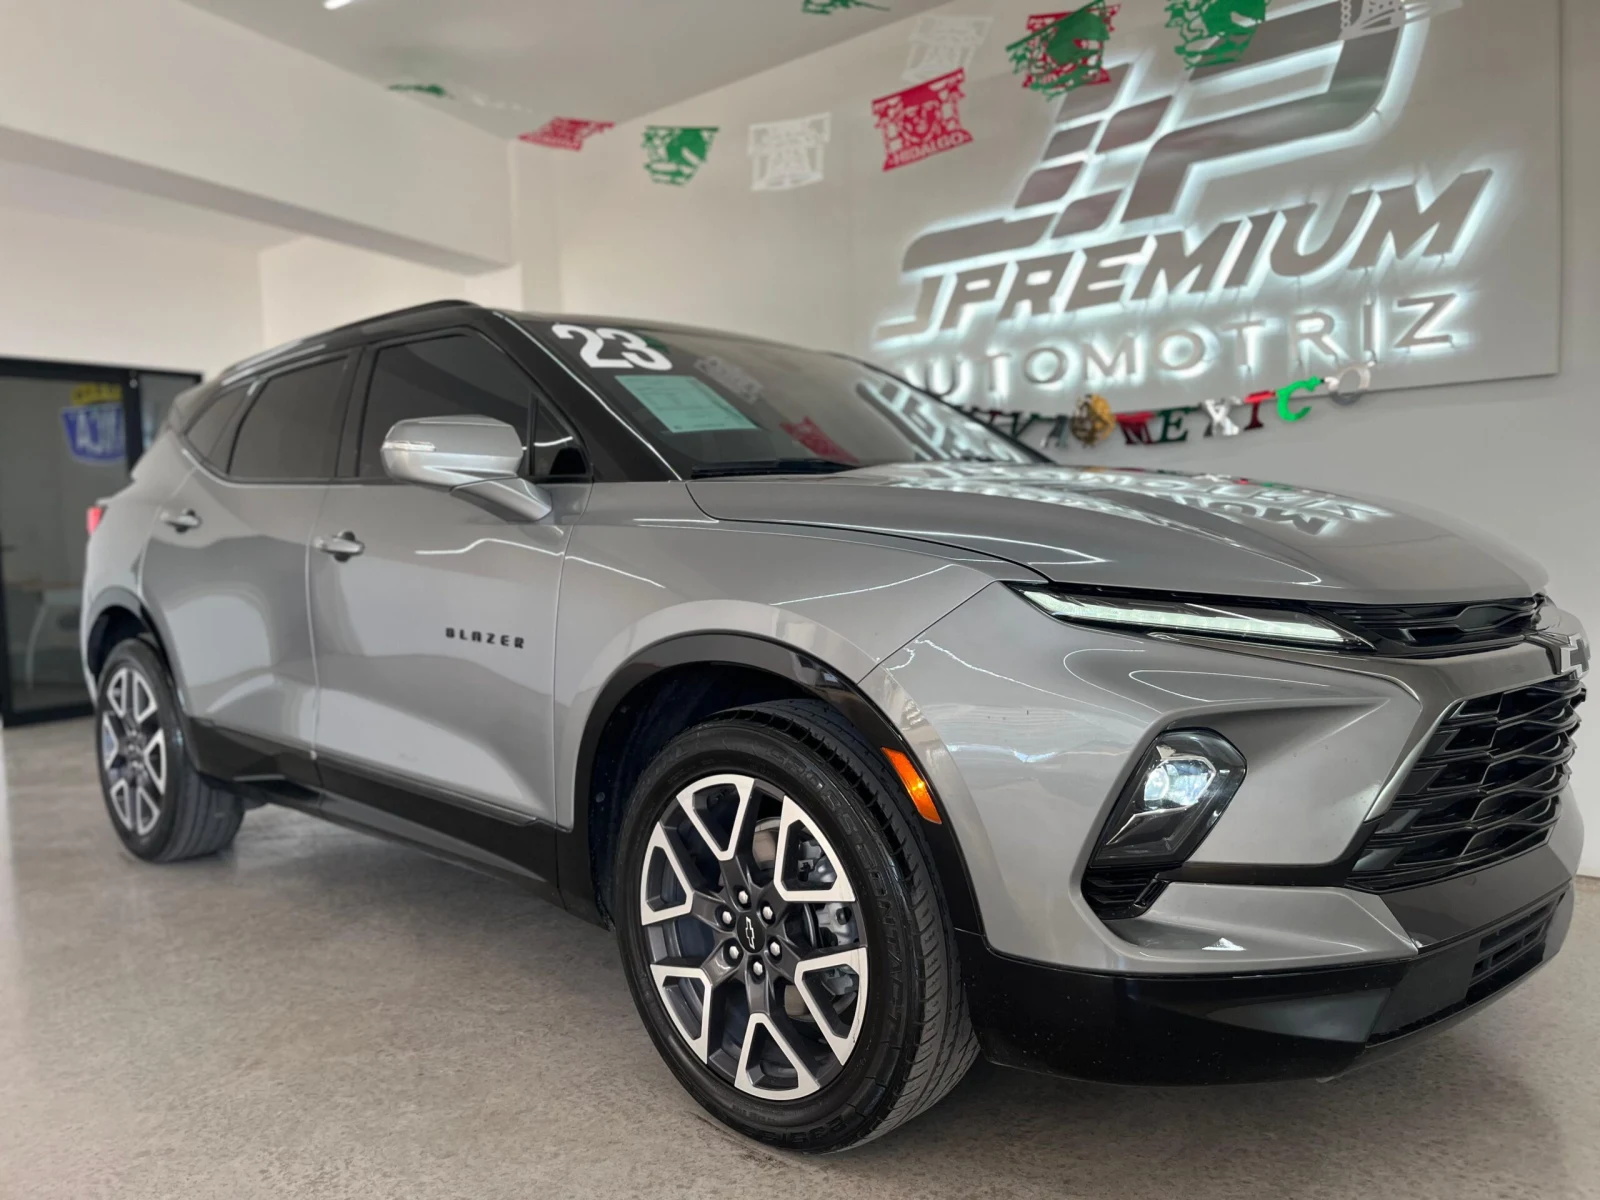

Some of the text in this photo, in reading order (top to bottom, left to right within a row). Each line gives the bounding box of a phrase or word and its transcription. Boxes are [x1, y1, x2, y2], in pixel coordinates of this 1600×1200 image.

[894, 132, 966, 164] HIDALGO
[938, 168, 1492, 331] PREMIUM
[552, 324, 673, 370] 23
[898, 293, 1457, 398] UTOMOTRIZ
[1115, 363, 1372, 446] MEXICO
[445, 627, 524, 649] BLAZER
